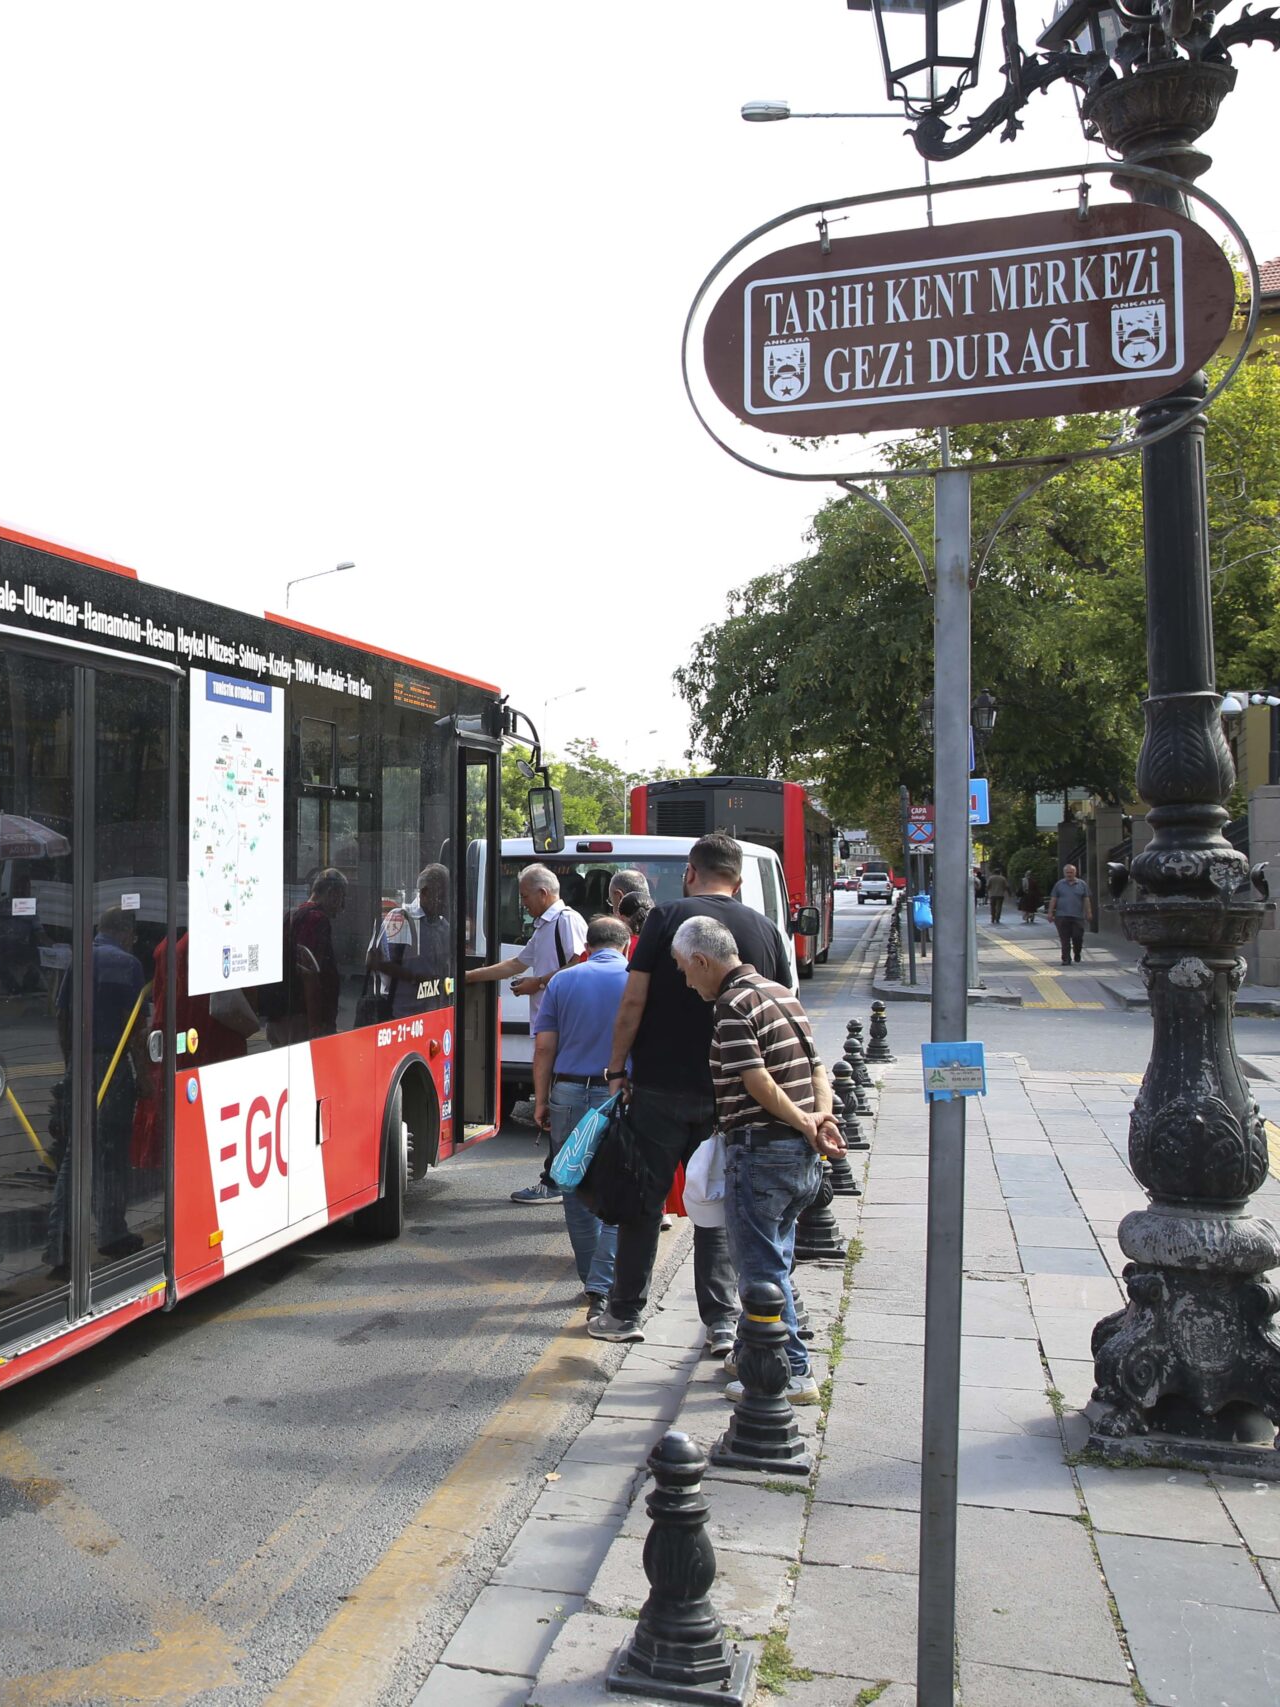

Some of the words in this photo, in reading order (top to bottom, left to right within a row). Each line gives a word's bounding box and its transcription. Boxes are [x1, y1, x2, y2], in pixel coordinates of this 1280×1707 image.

[886, 269, 979, 325] KENT
[1110, 298, 1165, 310] ANKARA
[764, 336, 811, 346] ANKARA
[928, 317, 1091, 385] DURAĞI
[177, 627, 207, 661] Heykel
[416, 979, 440, 1000] ATAK
[377, 1018, 424, 1047] EGO-21-406
